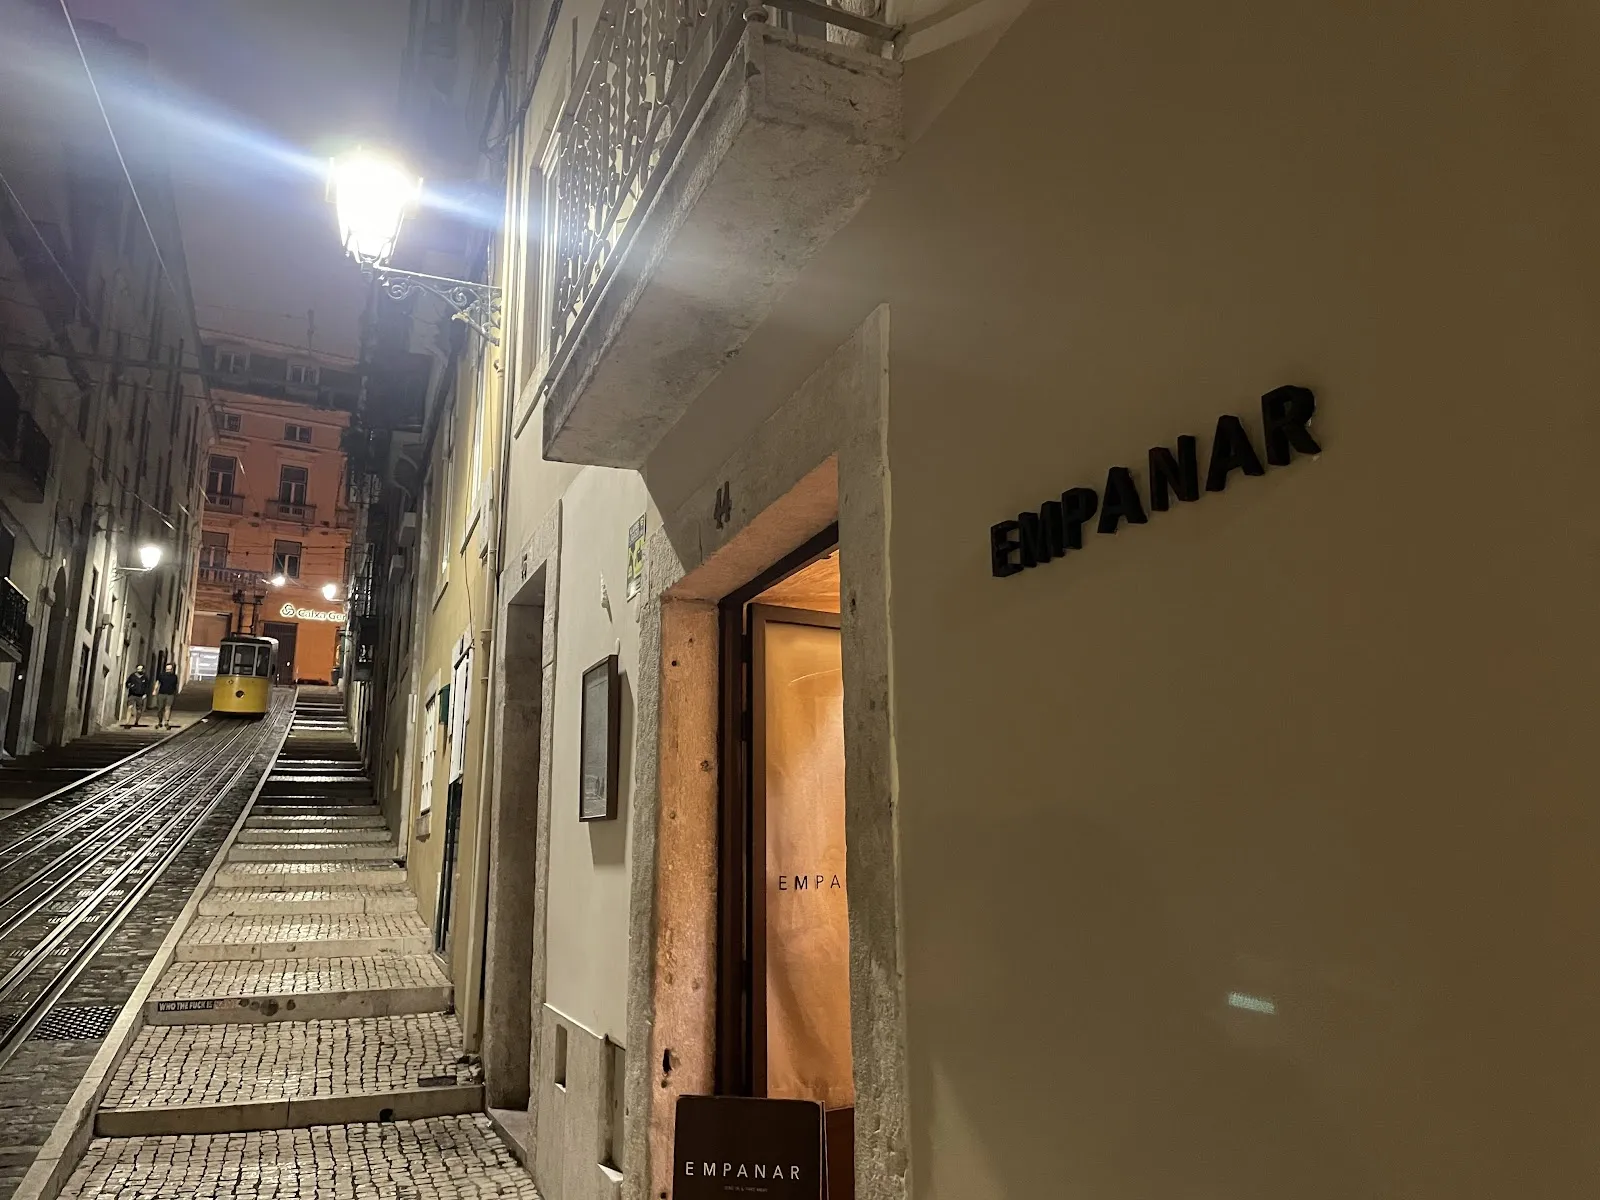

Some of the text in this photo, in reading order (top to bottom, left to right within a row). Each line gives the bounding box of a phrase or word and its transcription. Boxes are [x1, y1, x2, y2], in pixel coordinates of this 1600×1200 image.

[990, 385, 1322, 577] EMPANAR
[297, 608, 326, 620] Caixa
[778, 874, 841, 891] EMPA
[159, 1002, 176, 1011] WHO
[176, 1001, 189, 1010] THE
[189, 1000, 206, 1009] FUCK
[685, 1161, 800, 1180] EMPANAR
